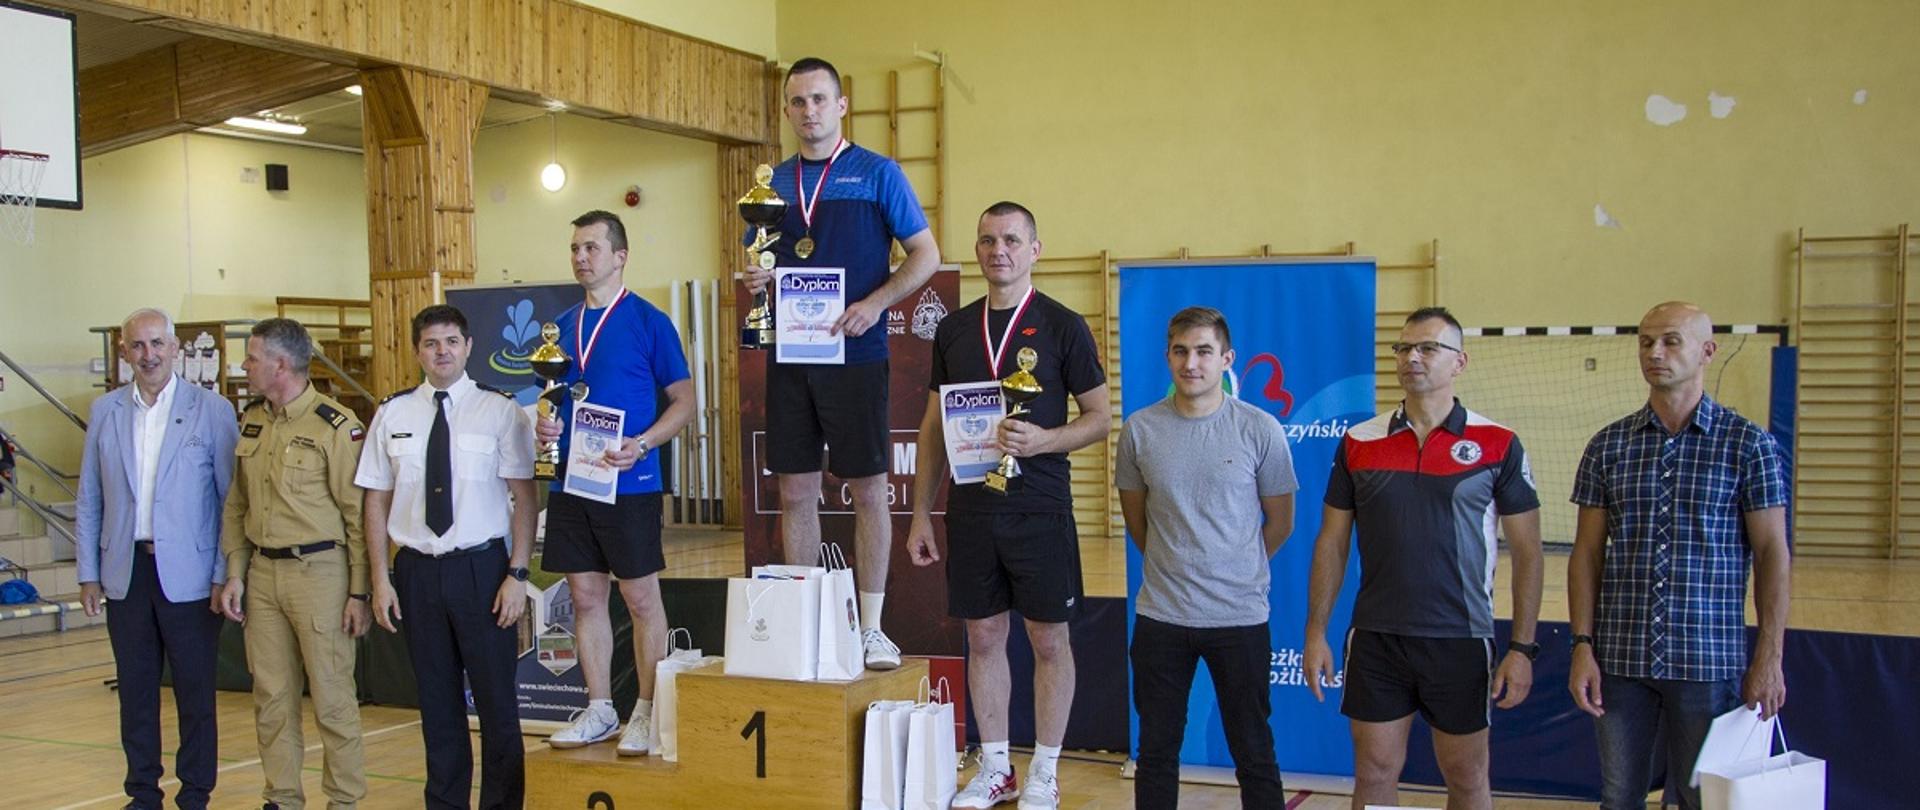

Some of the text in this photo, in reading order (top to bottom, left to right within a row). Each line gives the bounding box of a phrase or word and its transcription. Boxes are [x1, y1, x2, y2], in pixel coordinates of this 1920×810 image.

[791, 276, 840, 292] Dyplom
[954, 393, 1001, 409] Dyplom
[583, 411, 619, 431] Dyplom
[740, 711, 767, 779] 1
